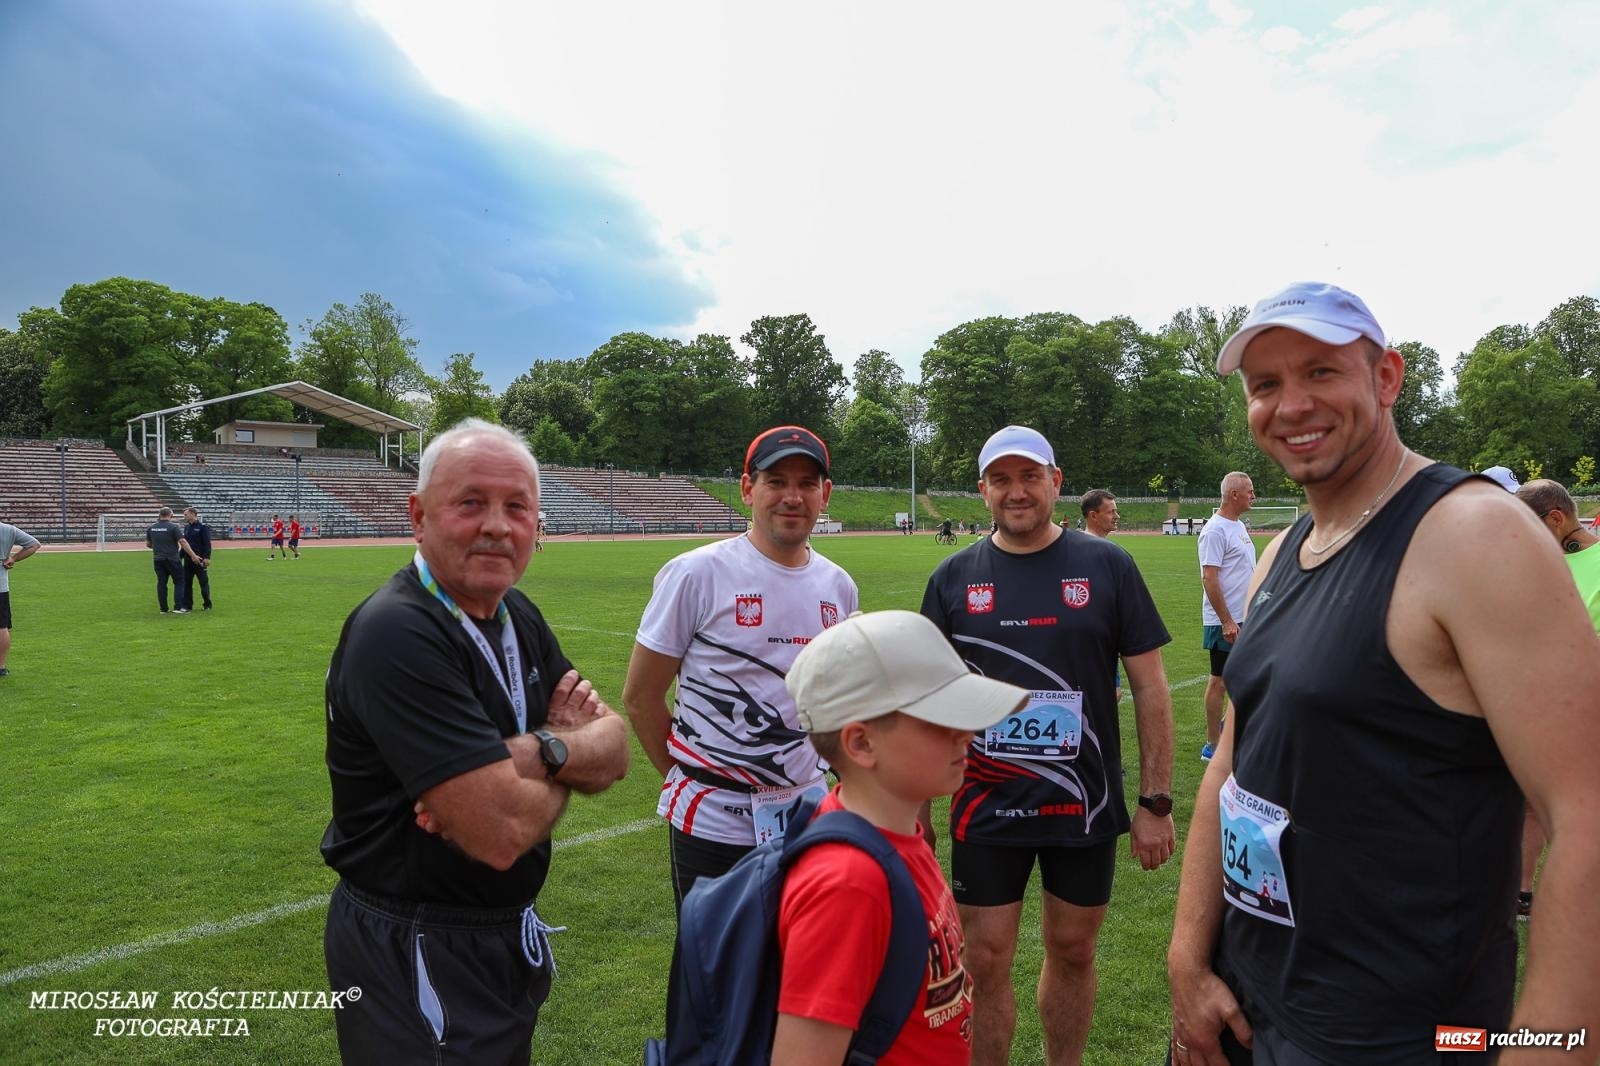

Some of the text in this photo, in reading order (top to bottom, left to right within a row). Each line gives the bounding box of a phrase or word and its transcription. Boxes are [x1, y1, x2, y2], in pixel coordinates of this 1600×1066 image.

[1045, 692, 1075, 700] GRANIC
[1007, 717, 1059, 741] 264
[1246, 797, 1282, 821] GRANIC
[1223, 827, 1252, 881] 154
